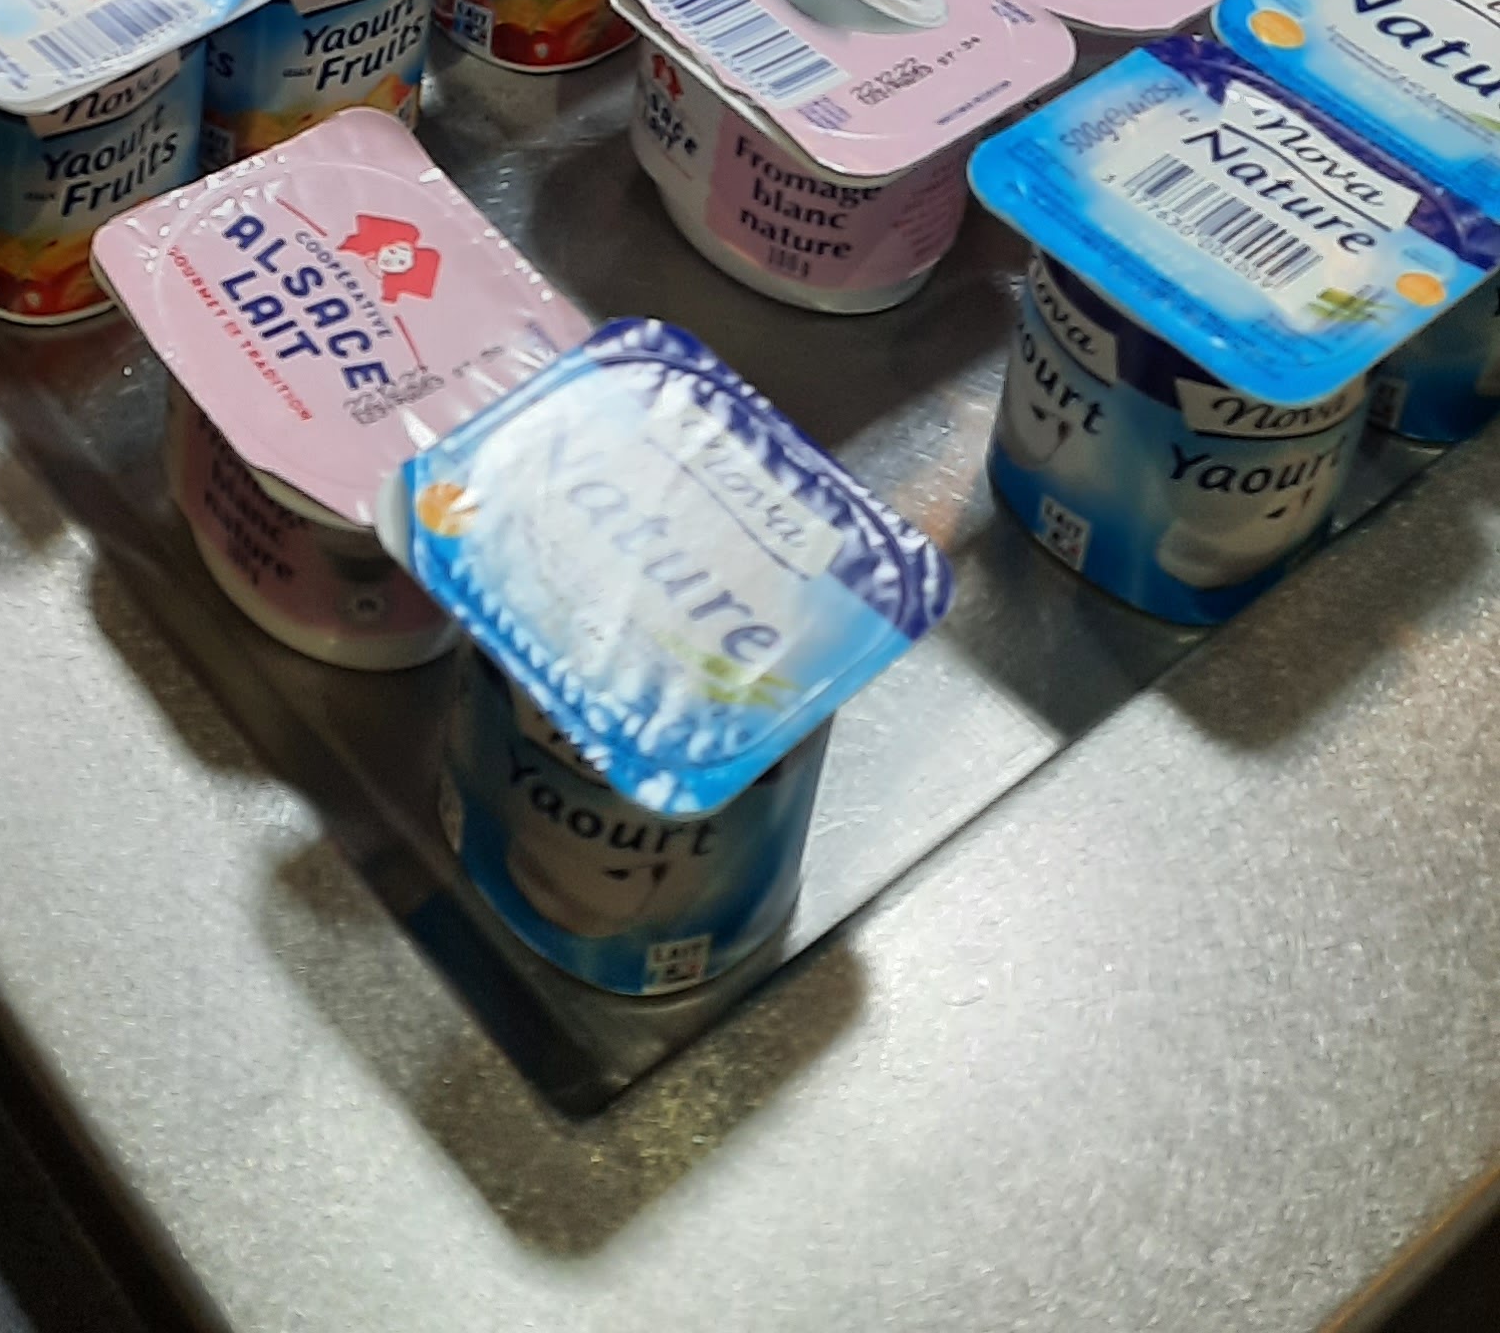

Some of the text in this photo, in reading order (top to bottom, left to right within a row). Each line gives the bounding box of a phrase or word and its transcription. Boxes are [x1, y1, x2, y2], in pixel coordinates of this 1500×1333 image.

[315, 13, 426, 91] Fruits
[43, 103, 165, 182] Yaourt
[60, 132, 179, 218] Fruits
[733, 132, 884, 210] Fromage
[751, 176, 849, 231] blanc
[1181, 129, 1377, 254] Nature
[738, 207, 854, 261] nature
[219, 270, 322, 360] LAIT
[222, 214, 391, 390] ALSACE
[505, 745, 714, 856] Yaourt
